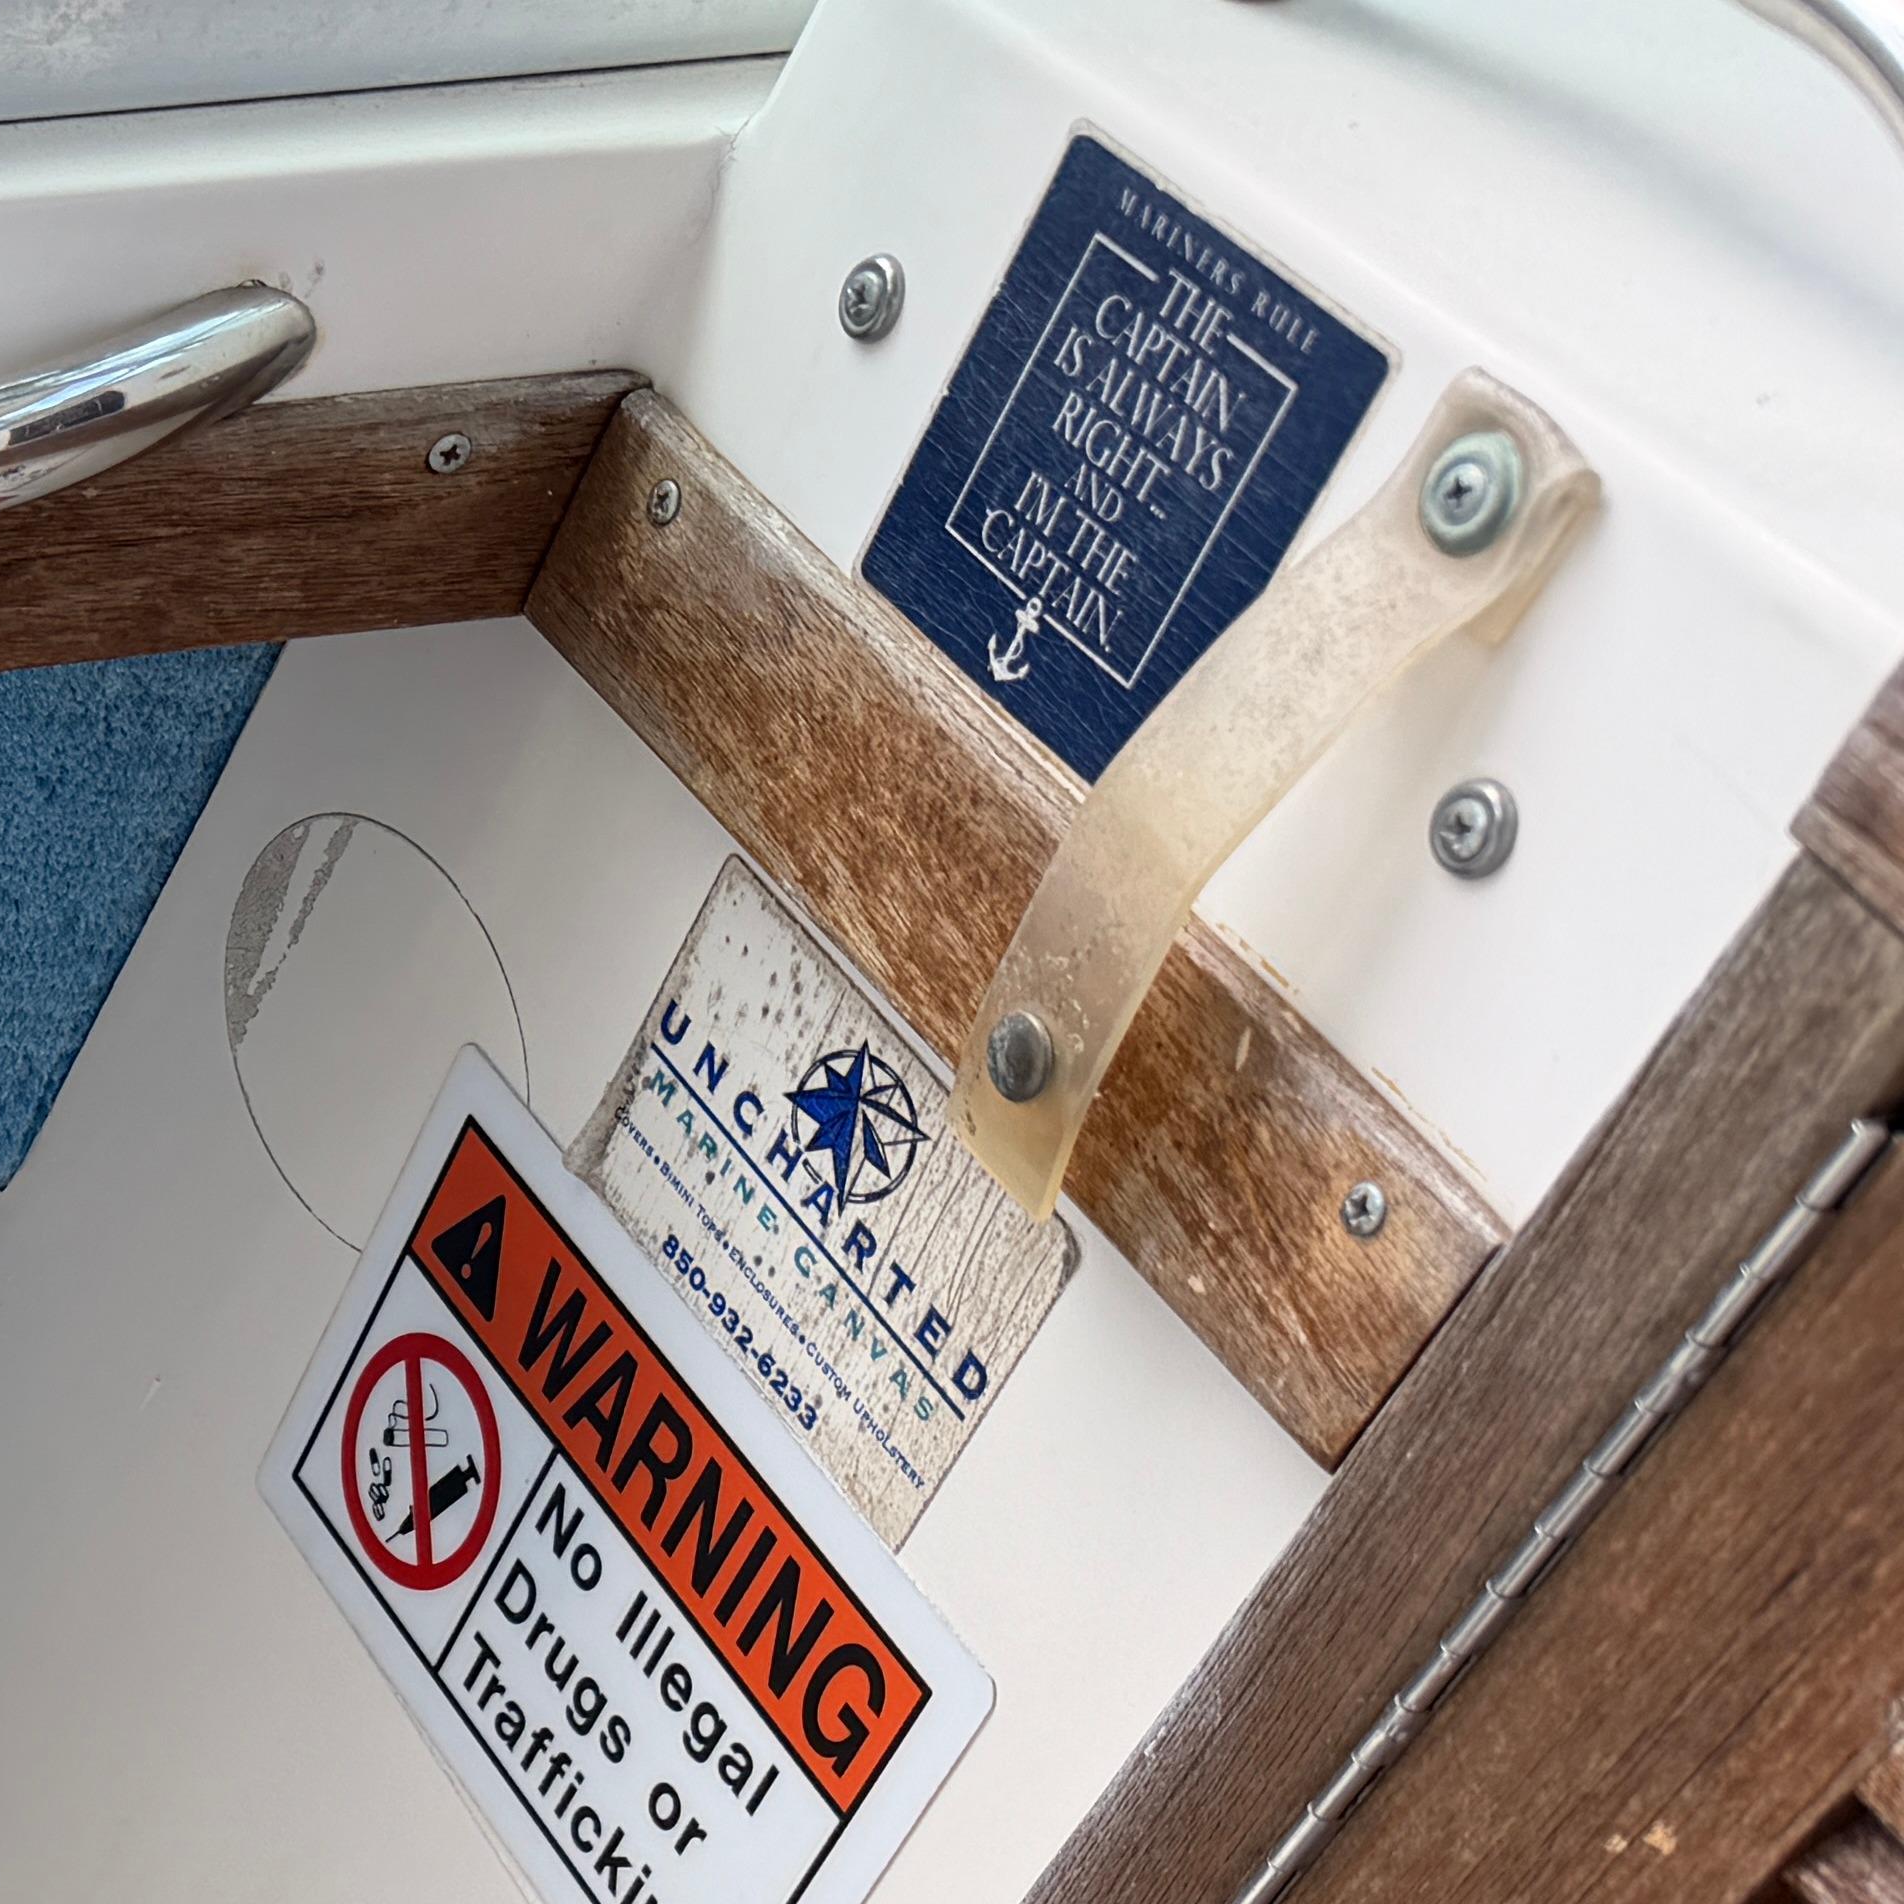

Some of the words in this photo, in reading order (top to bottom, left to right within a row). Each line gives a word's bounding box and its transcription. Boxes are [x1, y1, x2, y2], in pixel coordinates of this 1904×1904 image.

[1094, 293, 1240, 431] CAPTAIN
[1118, 189, 1243, 295] MARINERS
[1252, 285, 1320, 356] RULE
[1157, 269, 1234, 354] THE
[1053, 326, 1093, 378] IS
[1085, 353, 1235, 490] ALWAYS
[1064, 463, 1124, 523] AND
[981, 508, 1126, 653] CAPTAIN.
[1013, 469, 1061, 536] I'M
[1070, 510, 1139, 596] THE
[647, 1069, 780, 1234] MARINE
[793, 1245, 936, 1423] CANVAS
[658, 998, 990, 1402] UNCHARTED
[613, 1106, 655, 1158] COVERS
[658, 1159, 696, 1209] BIMINI
[695, 1202, 726, 1243] TOPS
[727, 1244, 800, 1336] ENCLOSURES
[805, 1339, 853, 1404] CUSTOM
[852, 1398, 928, 1491] UPHOLSTERY
[660, 1232, 821, 1432] 850-932-6233
[515, 1263, 889, 1782] WARNING
[492, 1558, 634, 1766] Drugs
[647, 1781, 710, 1859] or
[534, 1483, 606, 1594] No
[613, 1590, 781, 1818] Illegal
